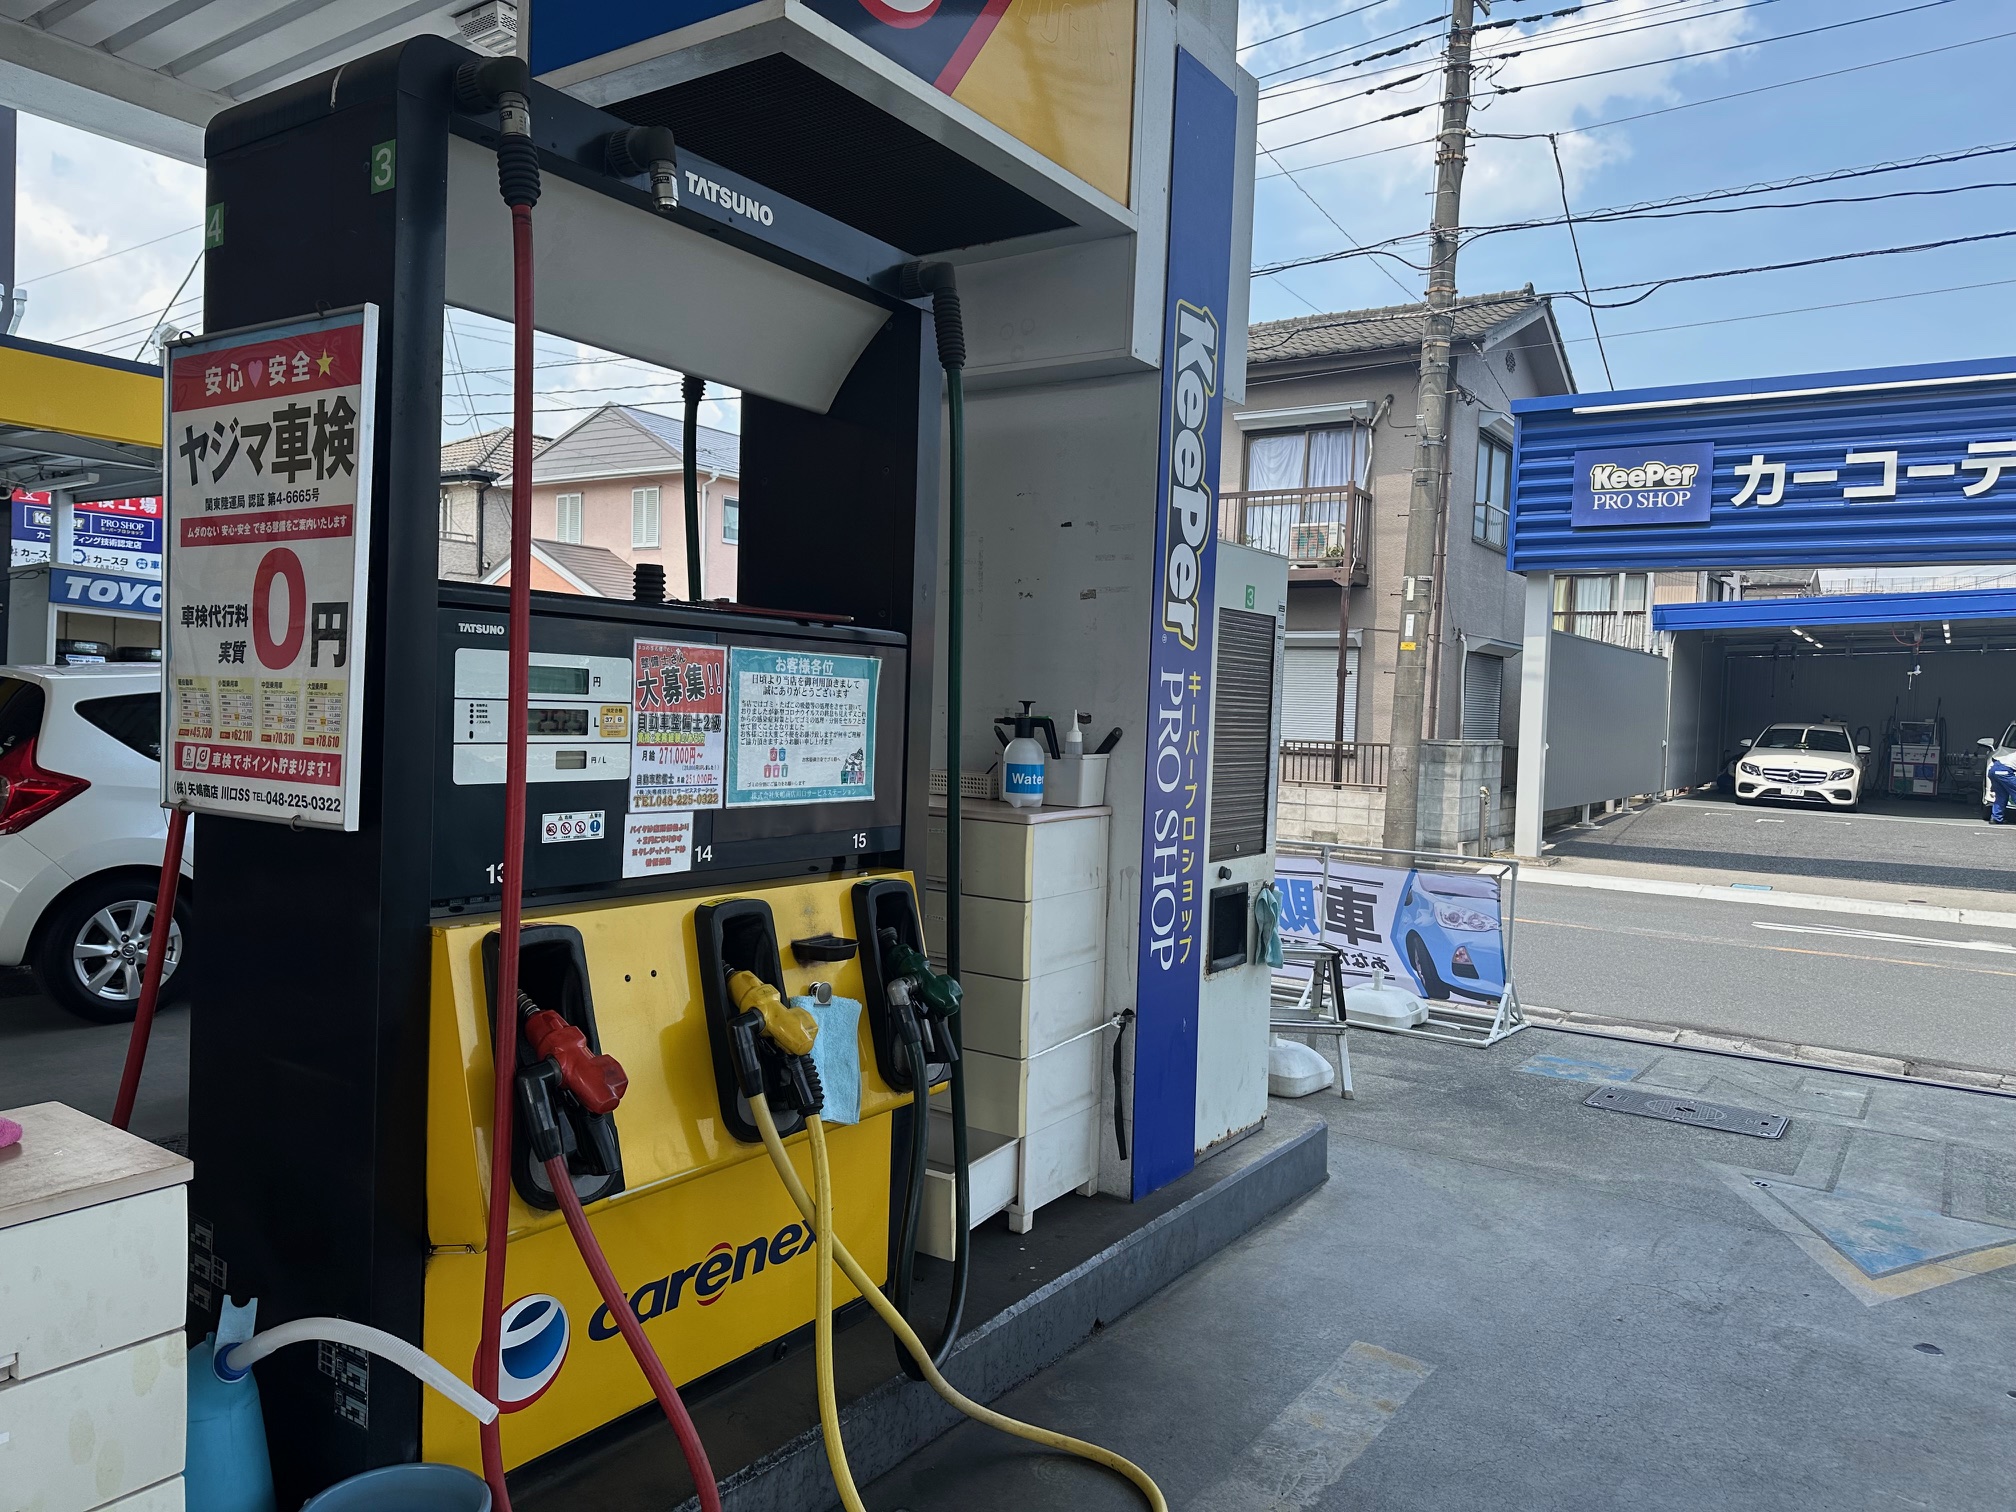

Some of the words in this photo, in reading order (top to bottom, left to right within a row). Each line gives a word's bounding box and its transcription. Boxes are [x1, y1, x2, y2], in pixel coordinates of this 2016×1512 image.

[374, 147, 392, 186] 3
[685, 170, 774, 226] TATSUNO
[206, 213, 222, 242] 4
[205, 363, 244, 397] 安心
[268, 351, 311, 387] 安全
[179, 395, 356, 487] ヤジマ車検
[1165, 303, 1217, 648] KeePer
[1591, 462, 1697, 491] KeePer
[1731, 441, 2016, 507] カーコーテ
[205, 494, 245, 512] 関東陸運局
[248, 493, 265, 508] 認証
[1592, 493, 1634, 510] PRO
[1636, 491, 1691, 509] SHOP
[100, 518, 120, 529] PRO
[121, 521, 145, 531] SHOP
[187, 525, 220, 539] ムダのない
[221, 522, 251, 537] 安心・安全
[253, 514, 347, 535] できる整備をご案内いたします
[1246, 588, 1254, 606] 3
[180, 603, 249, 628] 車検代行料
[458, 622, 505, 635] TATSUNO
[218, 640, 247, 664] 実質
[641, 653, 686, 669] 整備士さん
[775, 657, 834, 676] お客様各位
[593, 677, 601, 687] 円
[637, 663, 722, 710] 大募集!!
[752, 674, 860, 690] 日頃より当店を御利用頂きまして
[763, 686, 850, 698] 誠にありがとうございます
[594, 717, 600, 728] L
[638, 712, 721, 733] 自動車整備士2級
[1156, 667, 1185, 793] PRO
[211, 752, 331, 778] 車検でポイント貯まります!
[642, 750, 656, 762] 月給
[636, 773, 675, 786] 自動車整備士
[173, 780, 187, 795] (株)
[188, 782, 219, 799] 矢嶋商店
[221, 788, 250, 802] 川口SS
[1179, 671, 1202, 964] キーパープロショップ
[852, 832, 867, 848] 15
[694, 845, 712, 862] 14
[1150, 808, 1179, 971] SHOP
